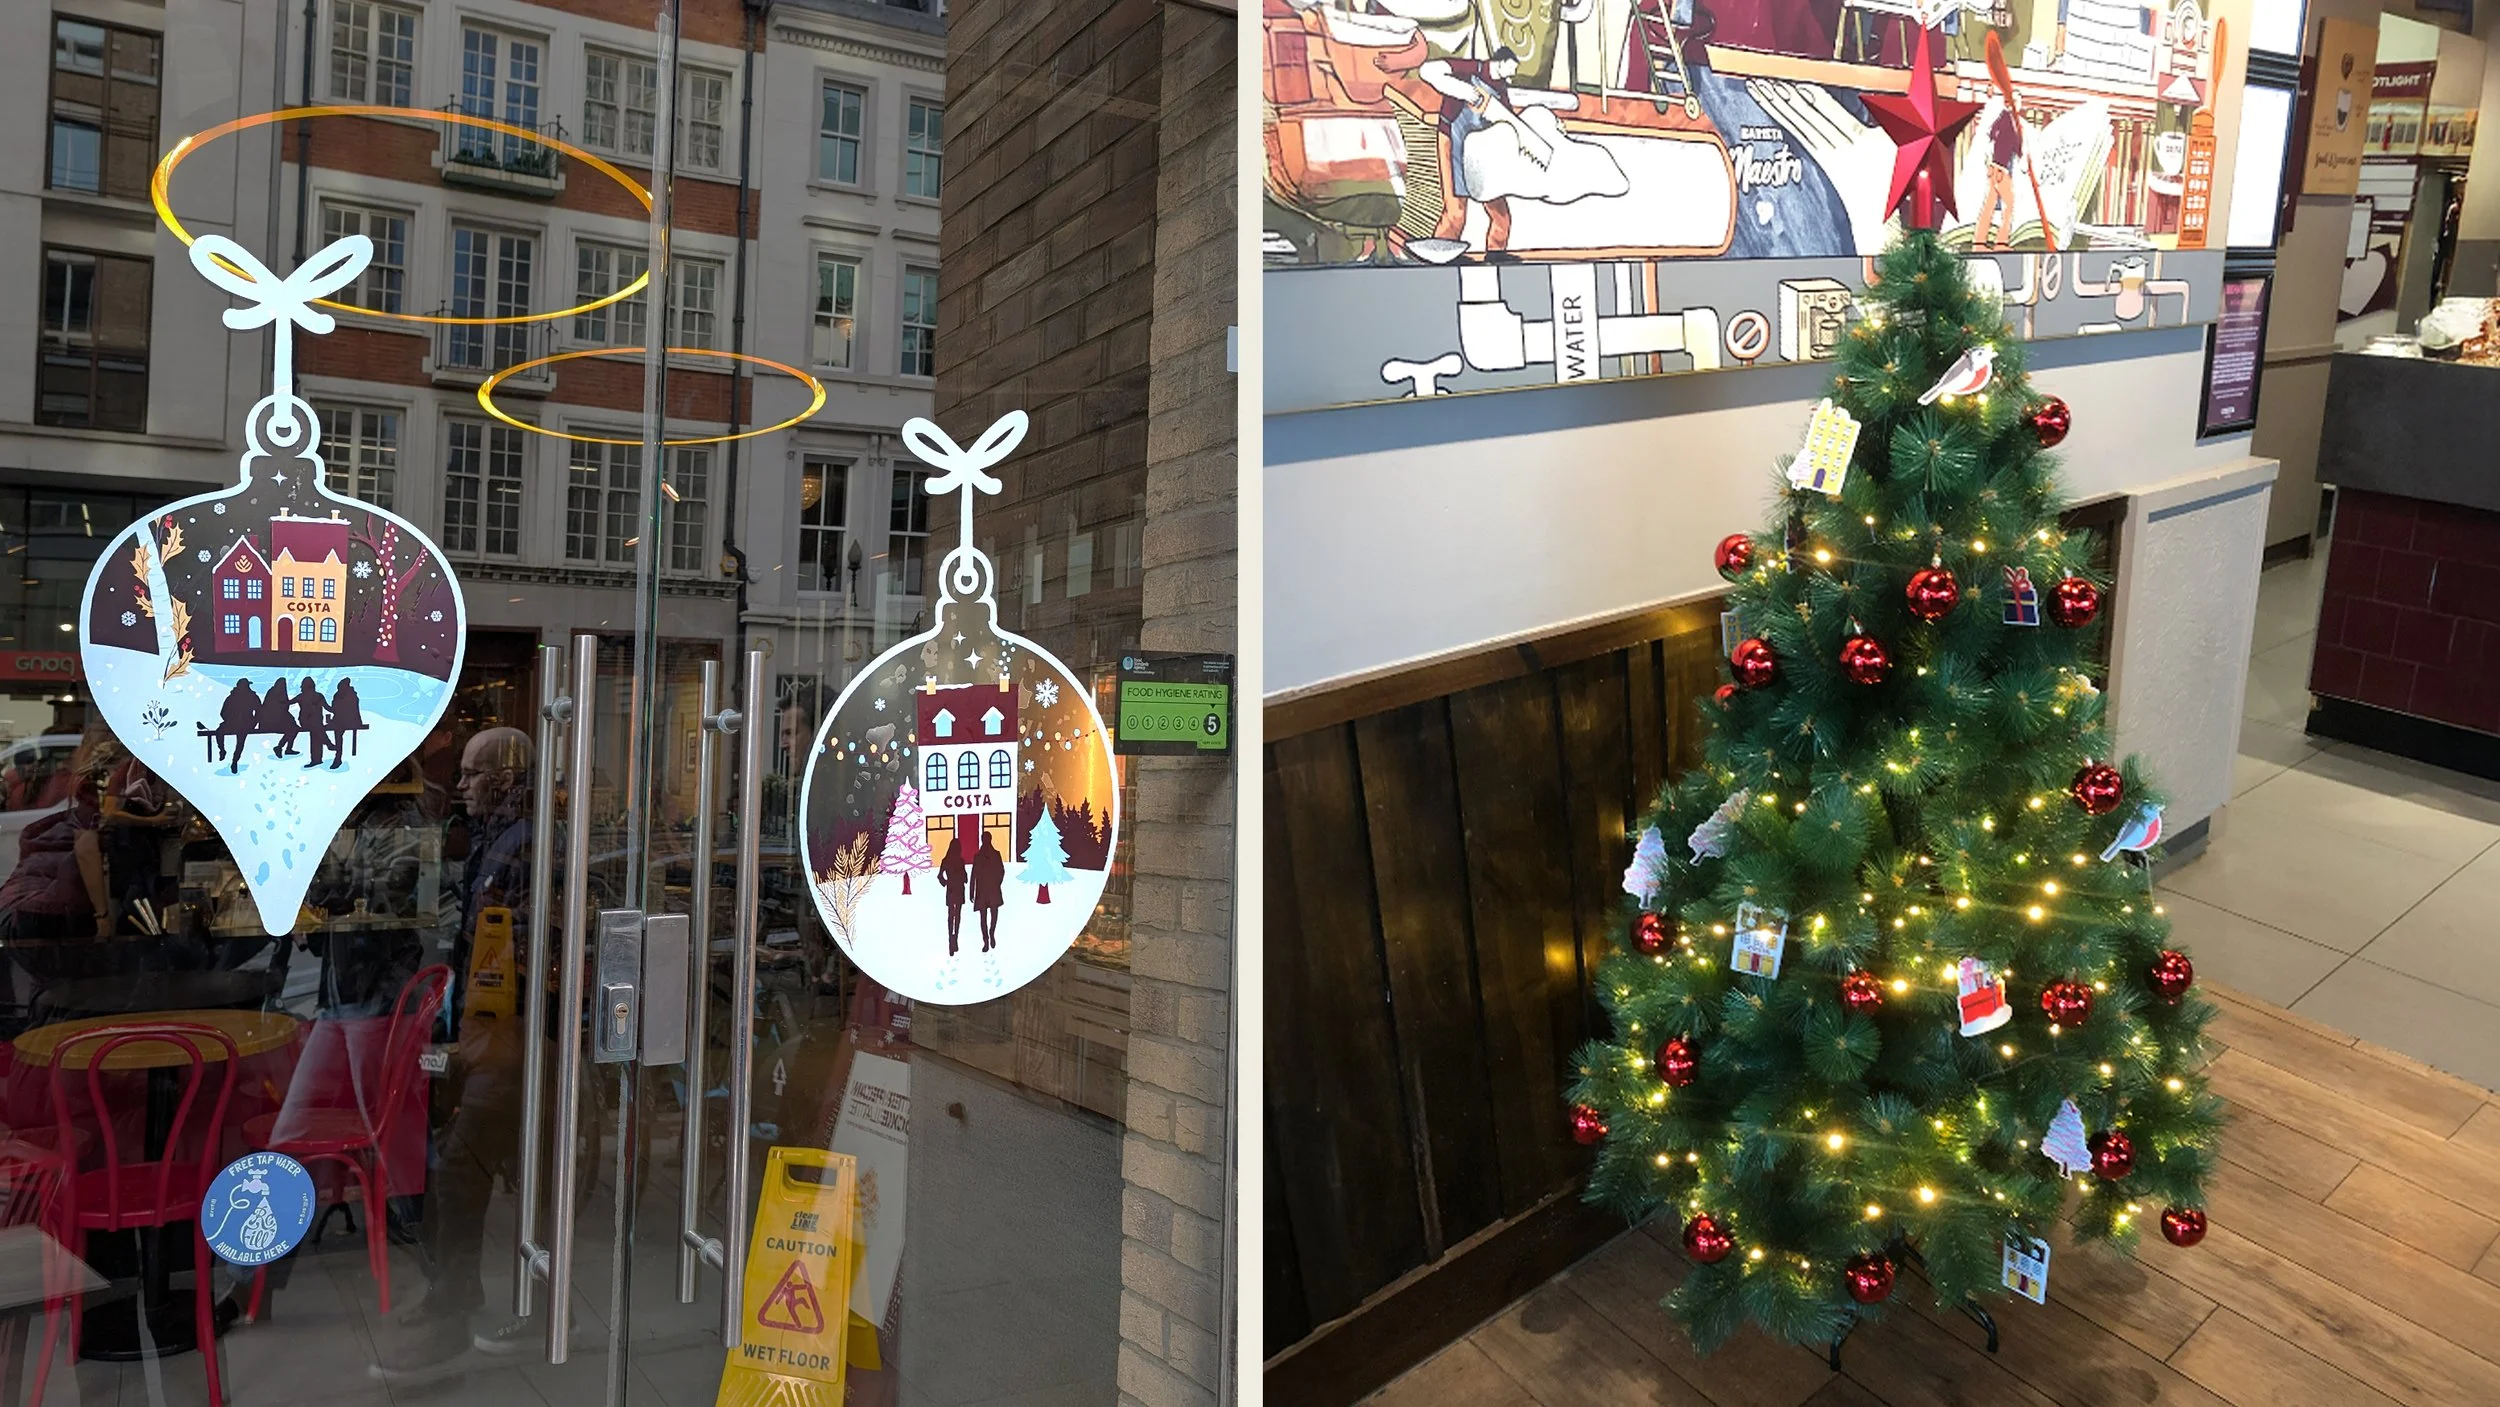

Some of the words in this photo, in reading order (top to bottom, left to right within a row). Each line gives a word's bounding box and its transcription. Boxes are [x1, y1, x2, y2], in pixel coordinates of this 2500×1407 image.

[1741, 127, 1783, 141] BARISTA
[1729, 142, 1802, 194] Maestro
[1562, 295, 1586, 380] WATER
[287, 602, 331, 613] COSTA
[1127, 687, 1153, 697] FOOD
[1156, 688, 1191, 698] HYGIENE
[1193, 689, 1222, 699] RATING
[944, 794, 992, 808] COSTA
[228, 1157, 254, 1176] FREE
[257, 1155, 274, 1165] TAP
[276, 1156, 301, 1177] WATER
[216, 1241, 261, 1262] AVAILABLE
[264, 1240, 289, 1259] HERE
[766, 1237, 837, 1257] CAUTION
[743, 1343, 776, 1362] WET
[780, 1349, 830, 1370] FLOOR
